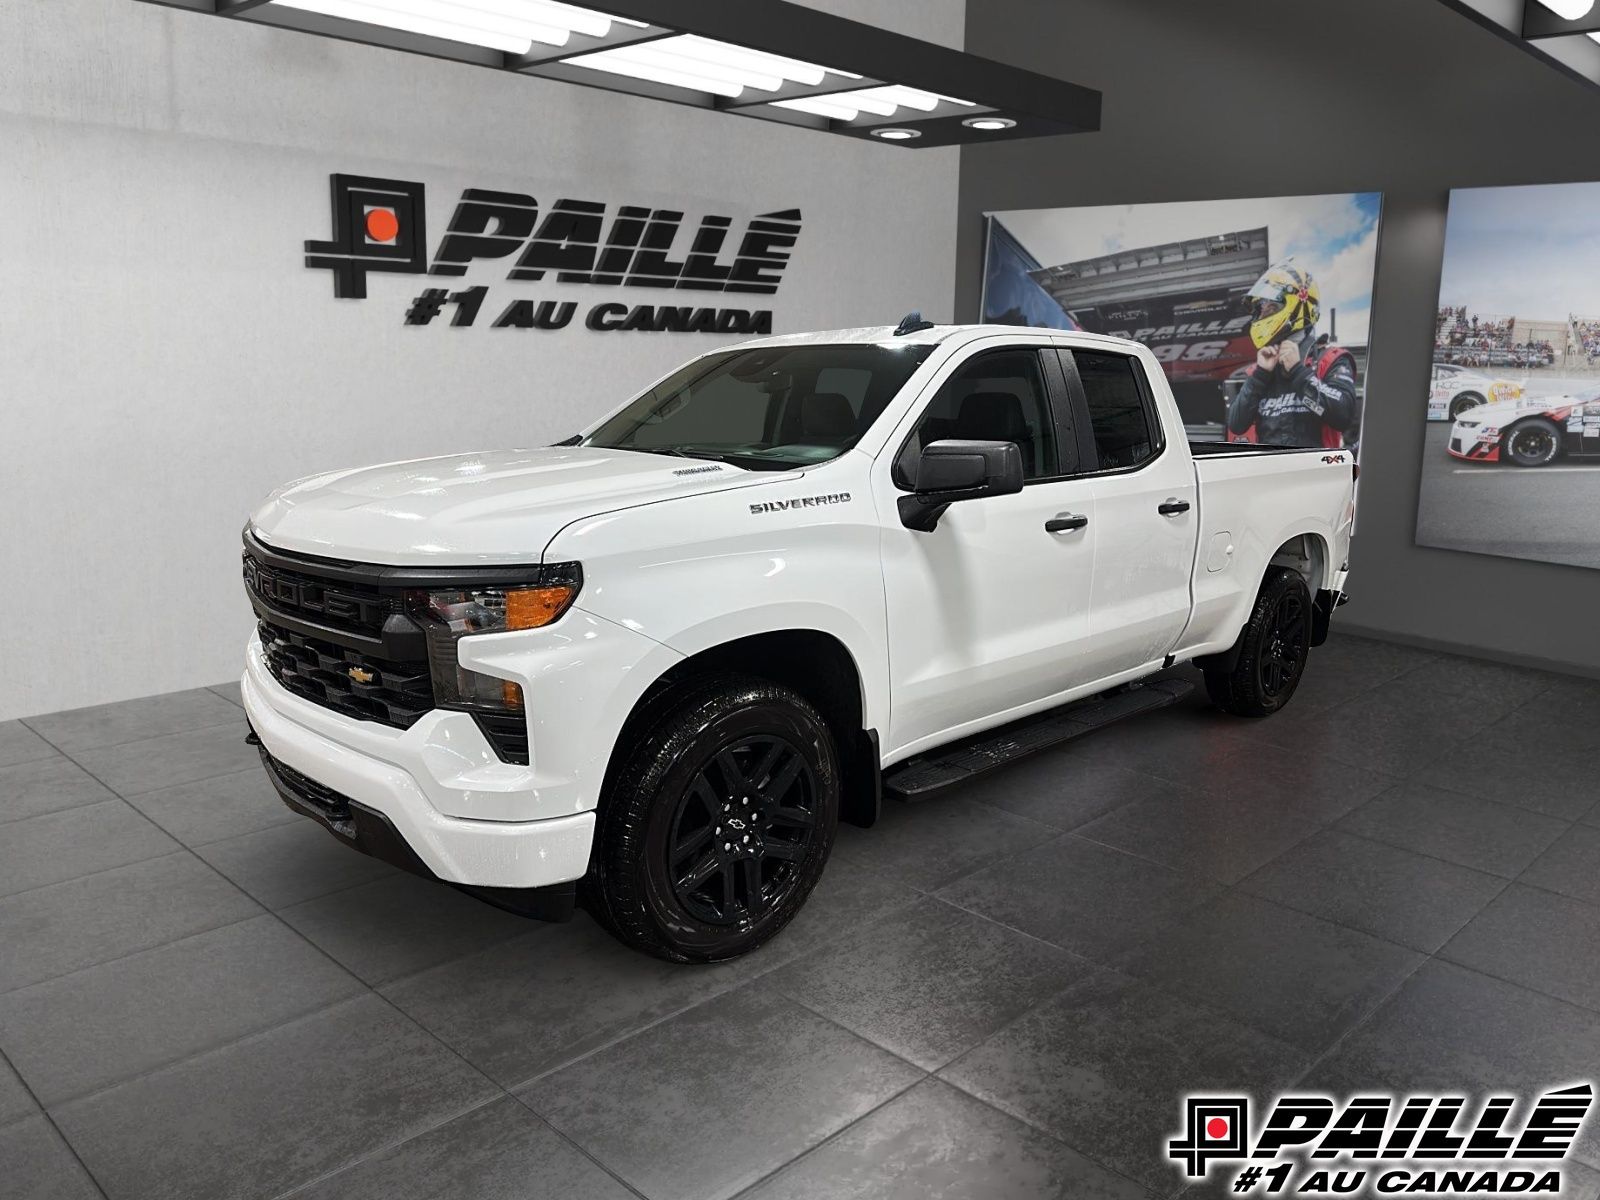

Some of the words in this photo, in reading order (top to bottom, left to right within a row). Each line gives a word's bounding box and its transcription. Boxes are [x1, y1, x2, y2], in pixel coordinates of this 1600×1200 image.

[427, 188, 803, 294] PAILLÉ
[404, 285, 490, 327] #1
[492, 299, 578, 330] AU
[586, 302, 773, 335] CANADA
[750, 491, 852, 515] SILVERADO
